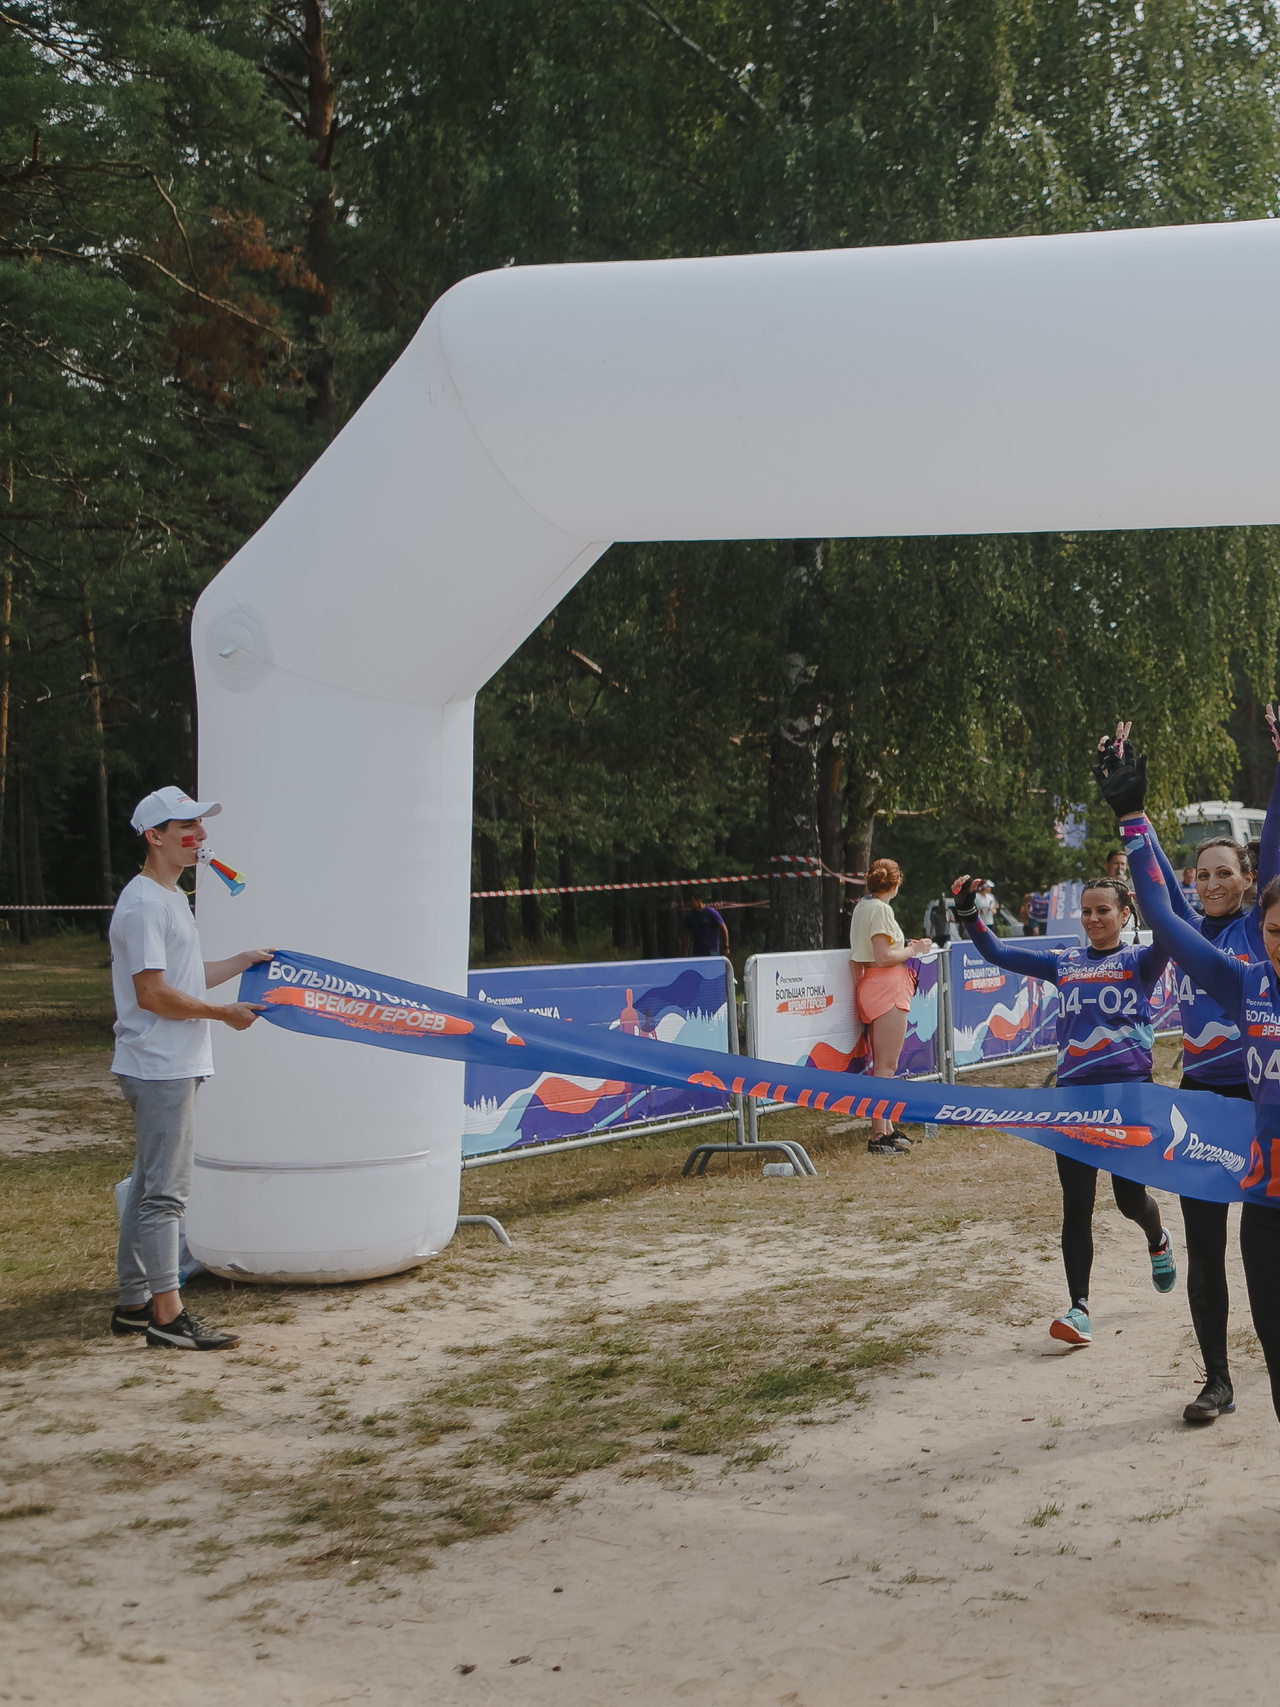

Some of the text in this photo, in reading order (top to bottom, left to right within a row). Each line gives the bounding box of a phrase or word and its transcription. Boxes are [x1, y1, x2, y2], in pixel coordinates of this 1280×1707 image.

[268, 961, 371, 1000] БОЛЬШАЯ
[776, 985, 826, 1000] БОЛЬШАЯ ГОНКА
[304, 990, 446, 1031] ВРЕМЯ ГЕРОЕВ
[934, 1104, 1051, 1124] БОЛЬШАЯ
